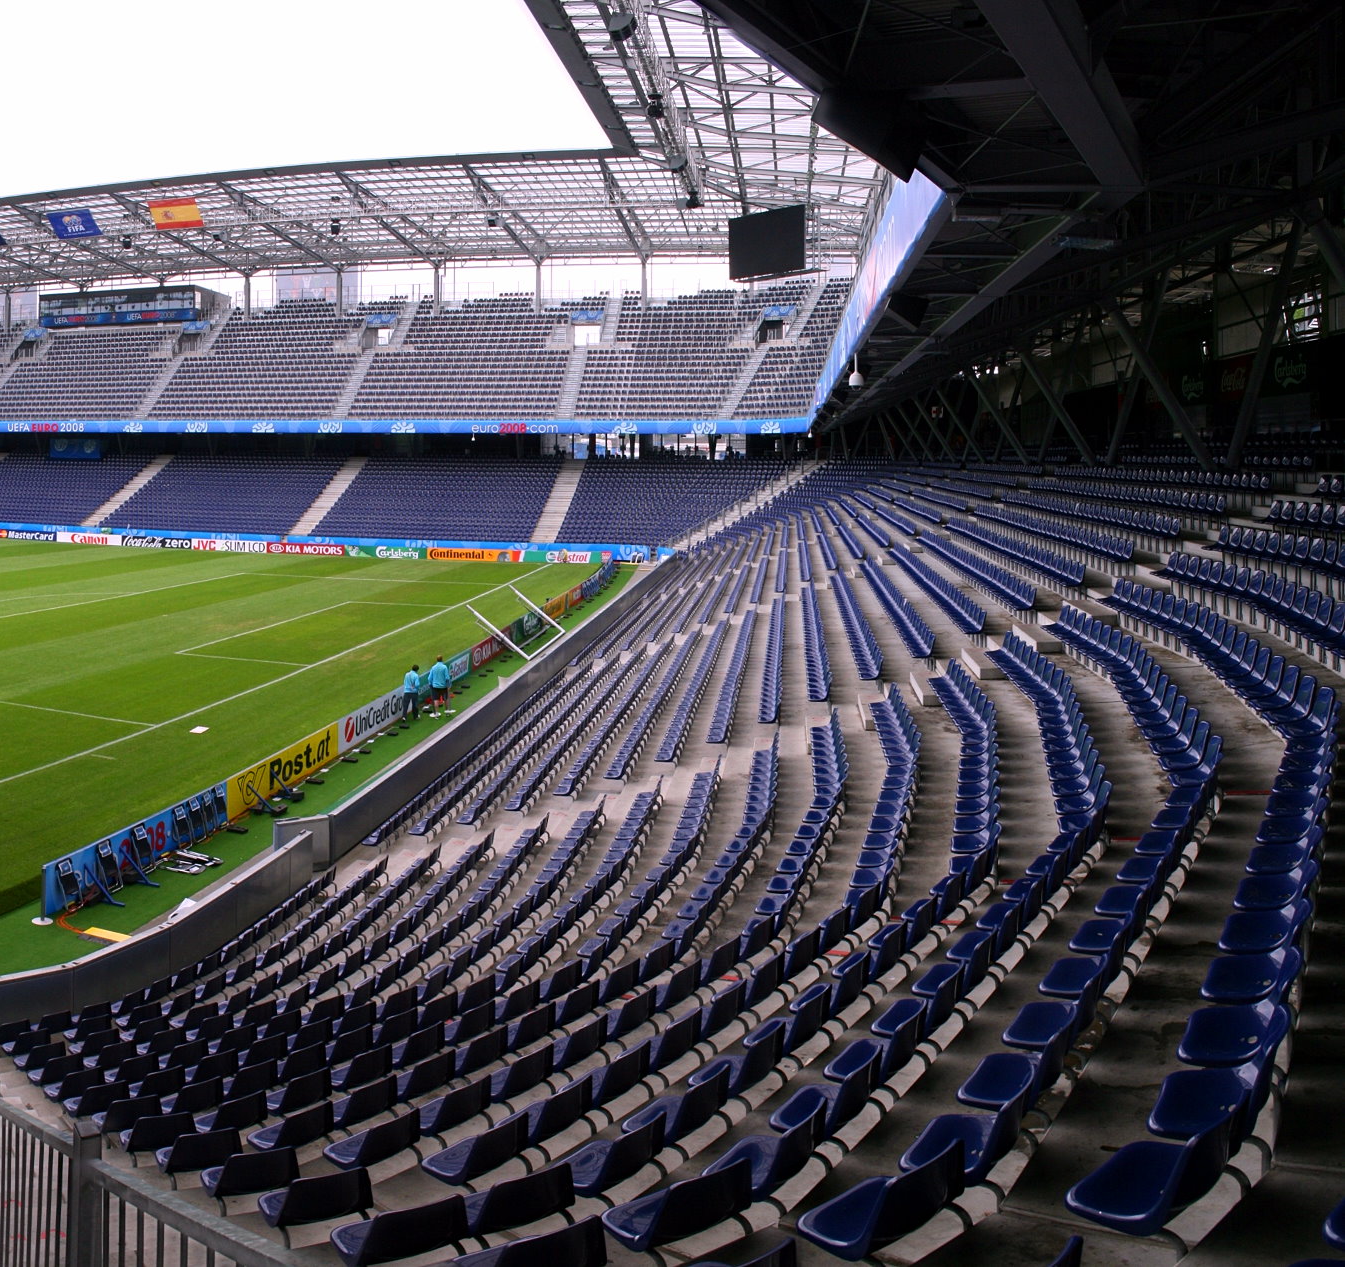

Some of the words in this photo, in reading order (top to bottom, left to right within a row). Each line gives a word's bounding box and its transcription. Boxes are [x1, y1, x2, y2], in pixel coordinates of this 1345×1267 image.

[1274, 357, 1306, 379] Carlsberg
[7, 422, 30, 432] UEFA
[32, 422, 59, 432] EURO
[60, 422, 84, 432] 2008
[8, 531, 54, 541] MasterCard
[71, 532, 108, 545] Canon
[165, 538, 191, 549] zero
[193, 540, 216, 550] JVC
[224, 541, 246, 552] SLIM
[248, 542, 266, 553] LCD
[285, 544, 302, 554] KIA
[303, 544, 343, 556] MOTORS
[376, 547, 419, 559] Carlsberg
[430, 548, 485, 560] Continental
[557, 552, 588, 563] strol
[355, 698, 390, 737] UniCredit
[390, 694, 404, 715] Gro
[269, 729, 331, 790] Post.at
